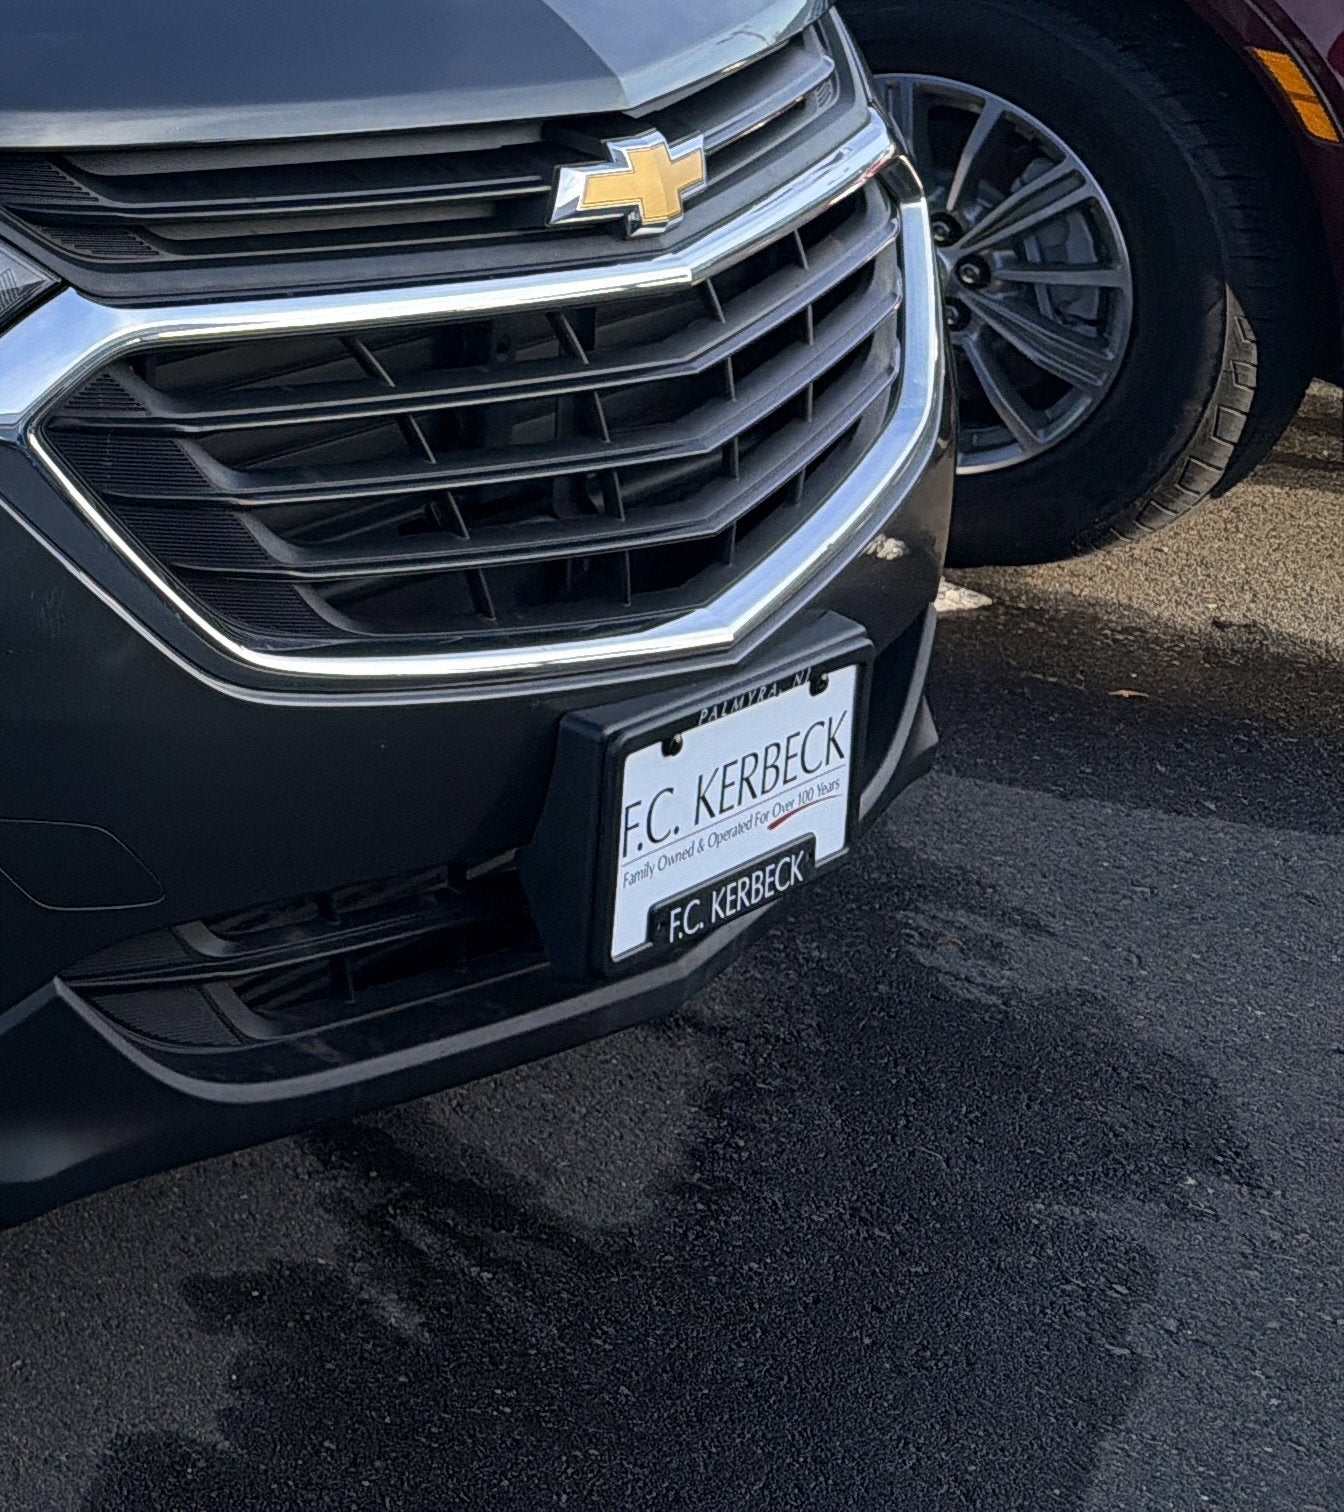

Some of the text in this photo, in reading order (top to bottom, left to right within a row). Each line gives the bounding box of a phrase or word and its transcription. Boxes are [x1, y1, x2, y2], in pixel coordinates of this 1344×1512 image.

[622, 710, 848, 859] F.C. KERBECK
[623, 777, 841, 890] Family Owned & Operated For Over 100 Years
[669, 849, 806, 944] F.C. KERBECK
